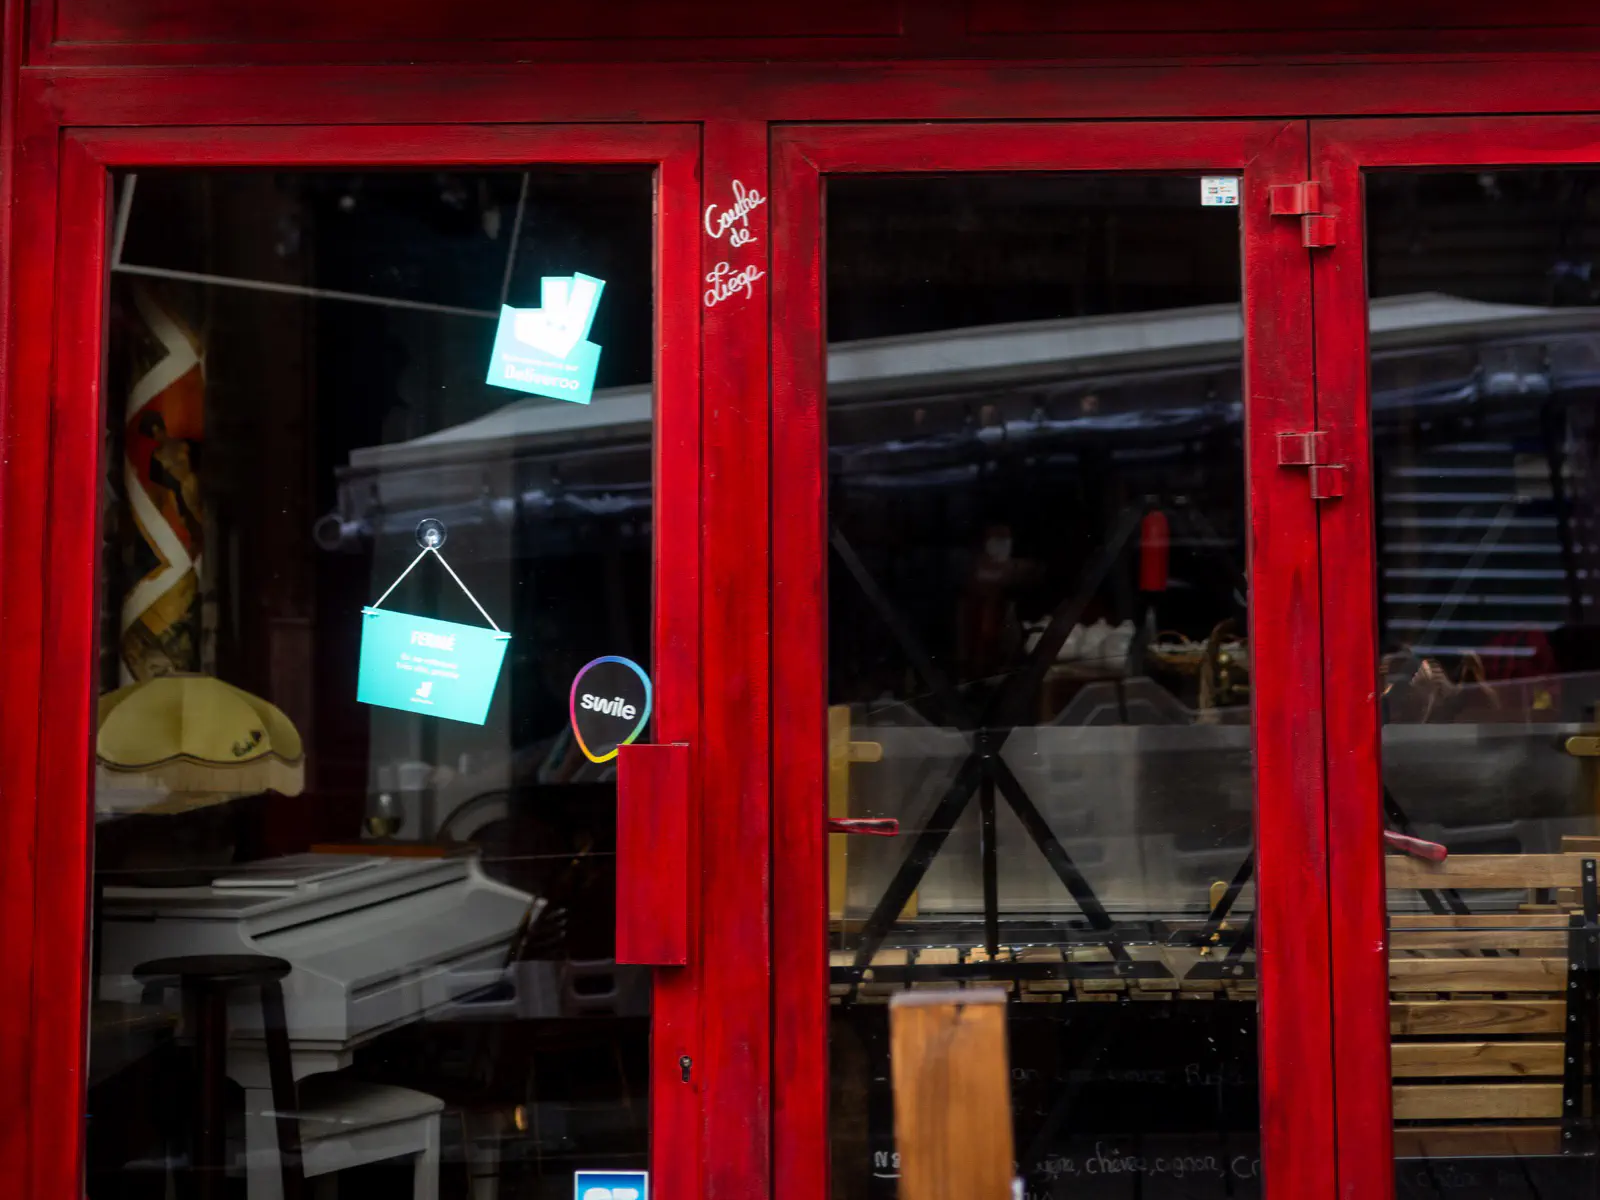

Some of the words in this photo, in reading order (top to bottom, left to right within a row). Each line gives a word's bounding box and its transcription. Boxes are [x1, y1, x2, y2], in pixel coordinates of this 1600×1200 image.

[730, 227, 757, 248] de
[504, 363, 580, 391] Deliveroo
[580, 693, 637, 720] swile
